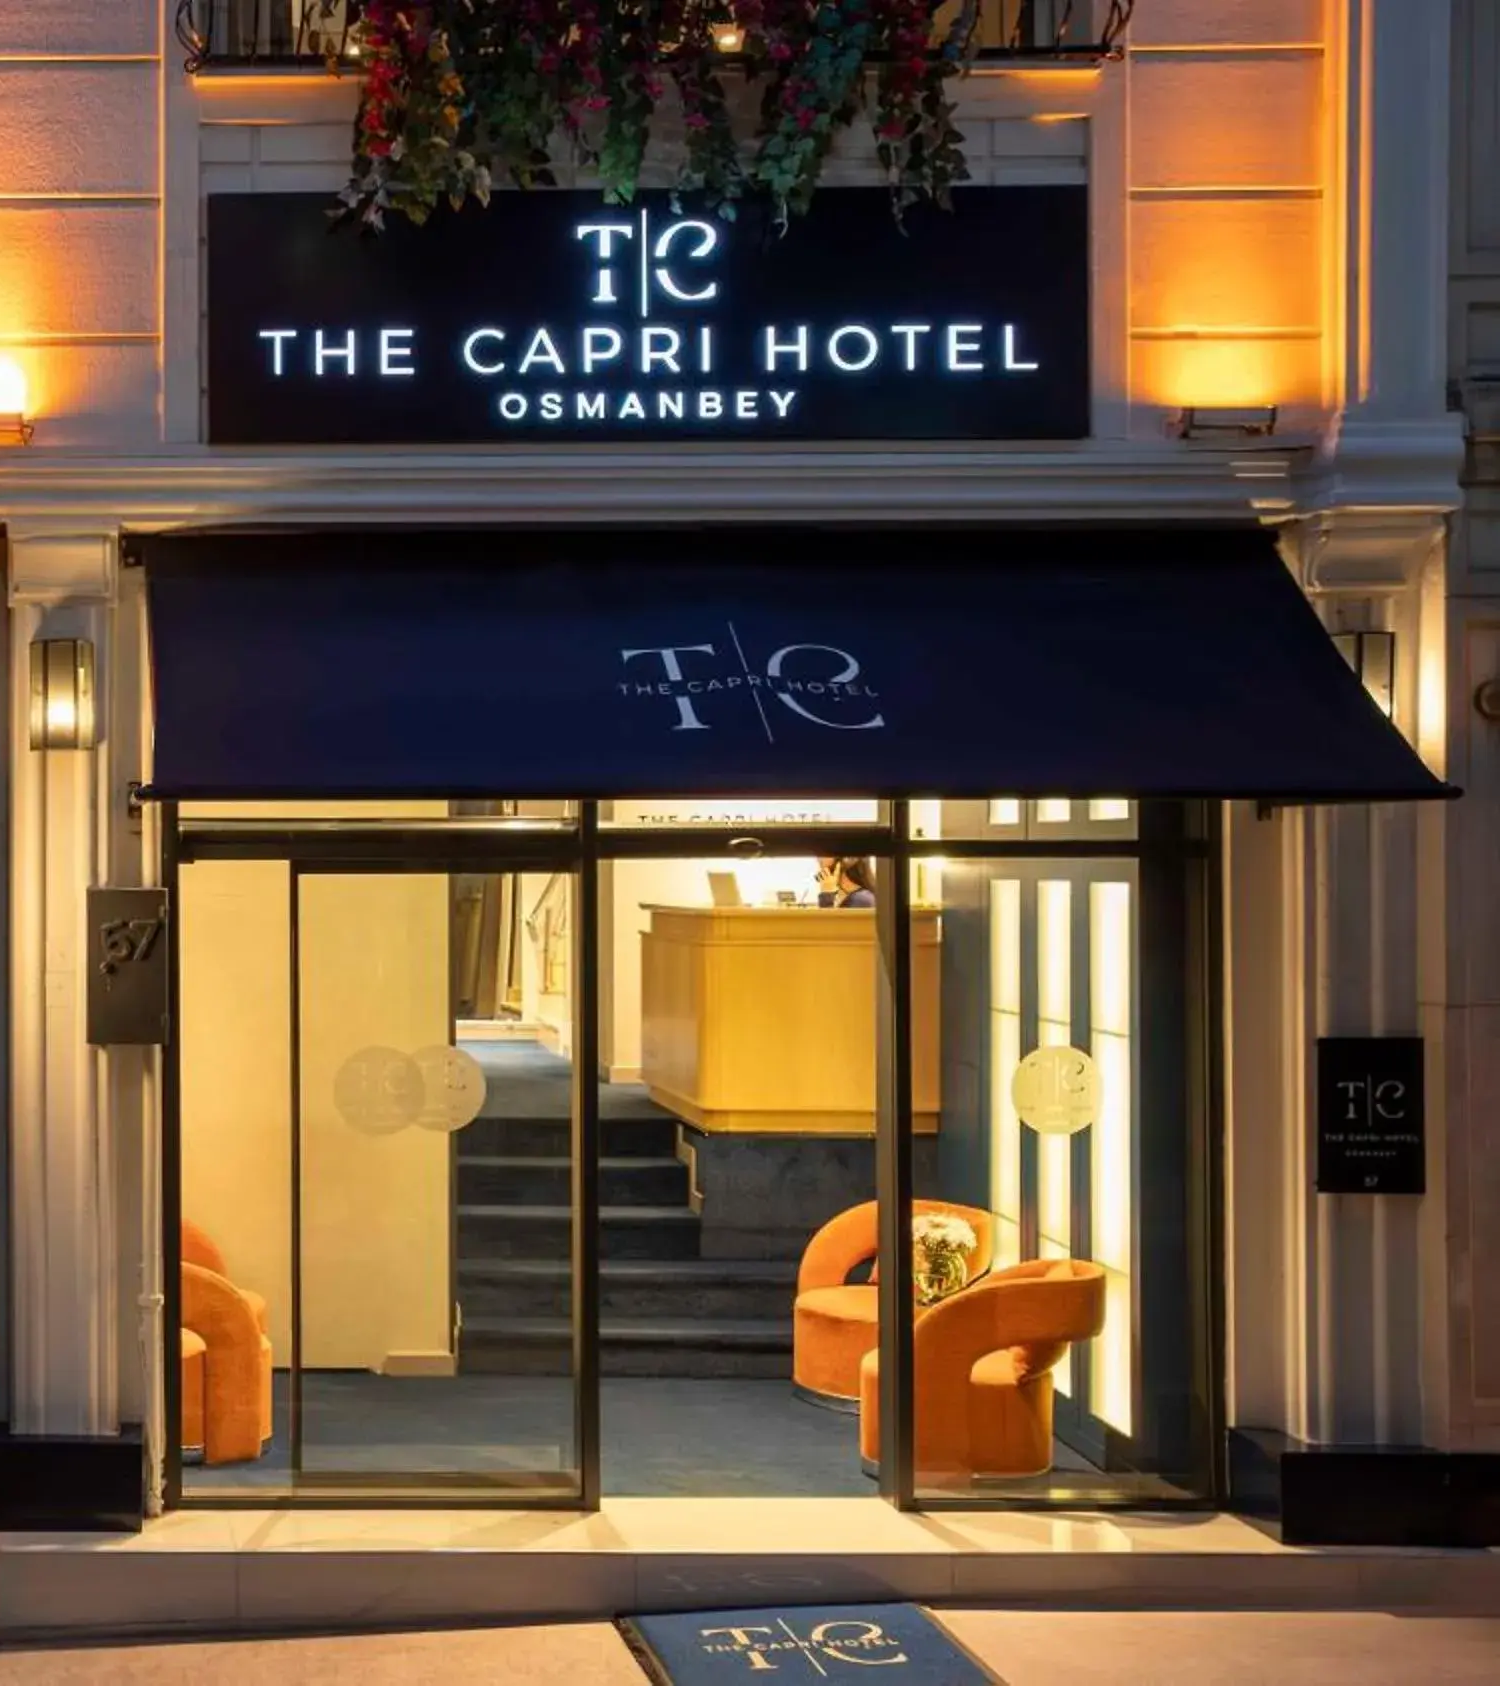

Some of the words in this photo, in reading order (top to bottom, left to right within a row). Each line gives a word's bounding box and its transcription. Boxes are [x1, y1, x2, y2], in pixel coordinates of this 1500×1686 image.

[259, 328, 415, 376] THE
[463, 327, 711, 375] CAPRI
[765, 324, 1039, 372] HOTEL
[499, 390, 796, 421] OSMANBEY
[617, 682, 672, 695] THE
[687, 675, 774, 693] CAPRI
[786, 679, 879, 701] HOTEL
[99, 905, 166, 976] 57
